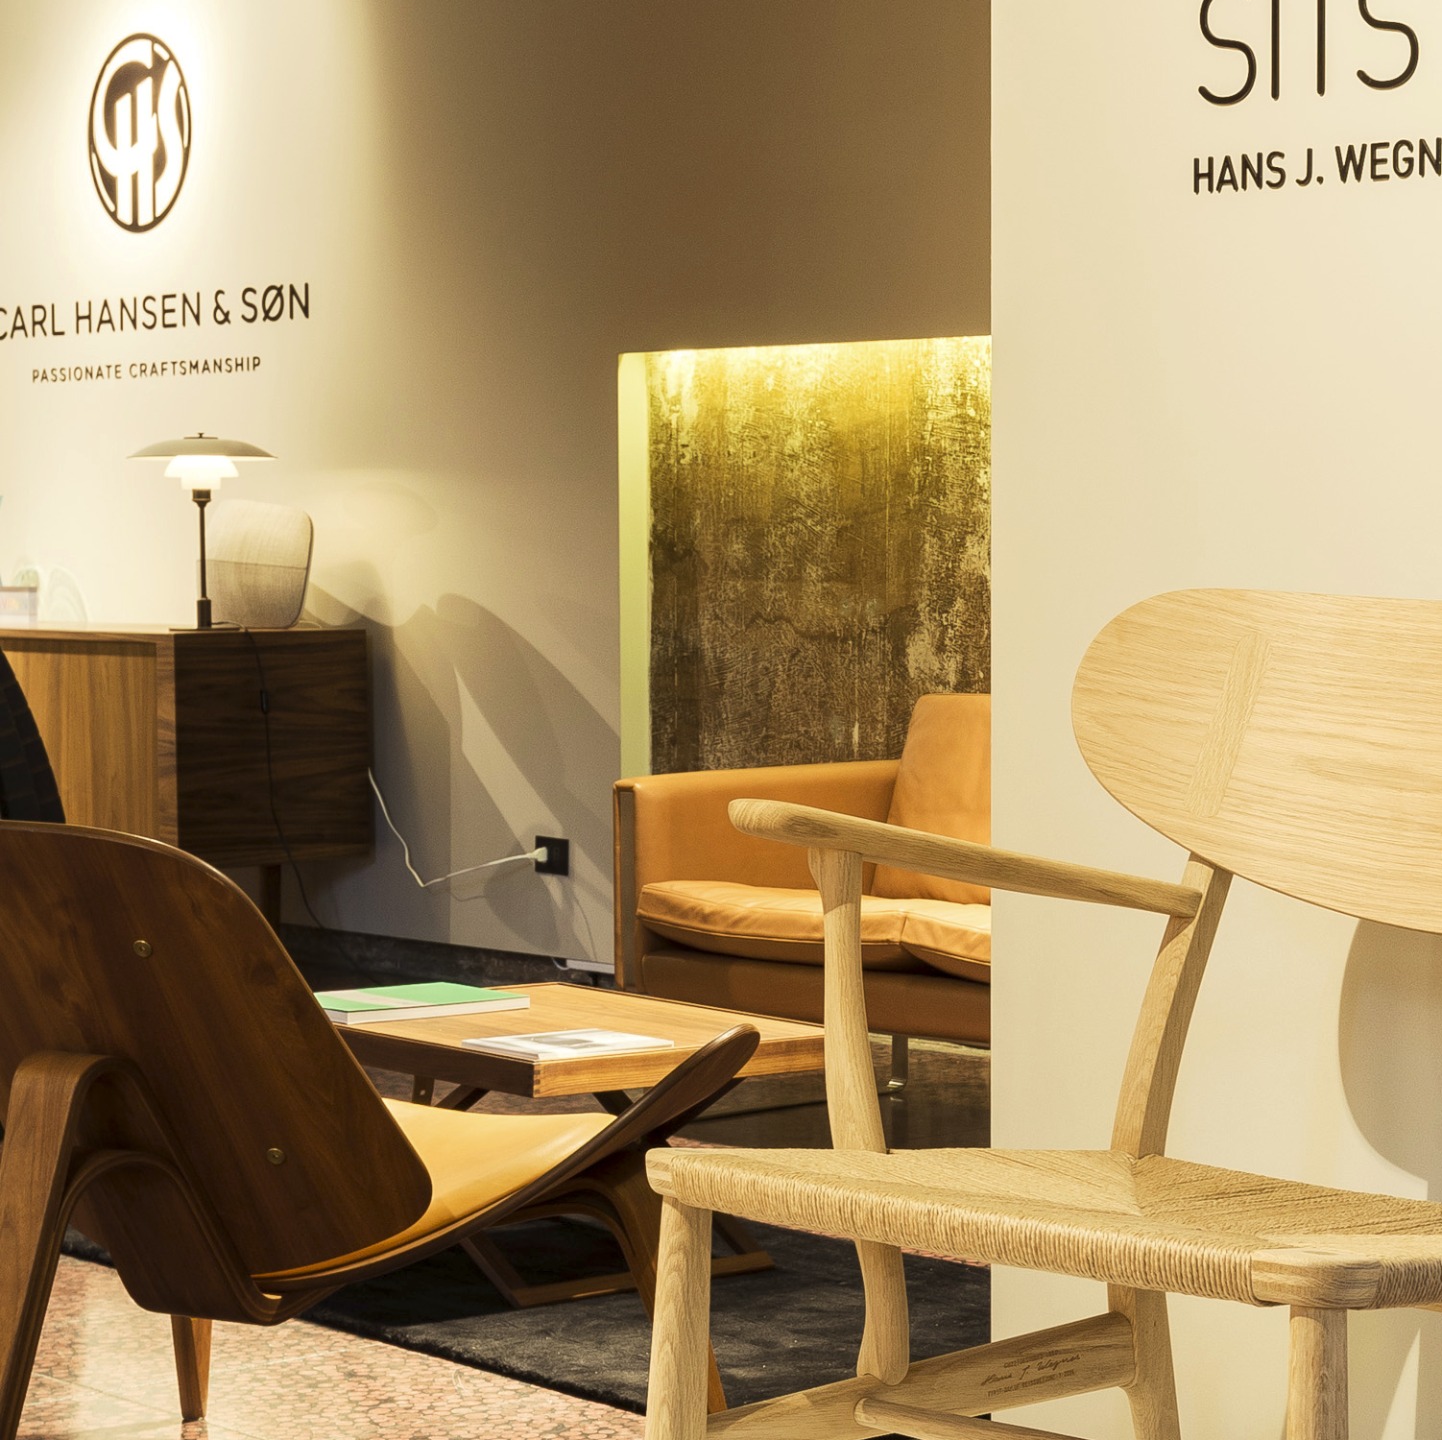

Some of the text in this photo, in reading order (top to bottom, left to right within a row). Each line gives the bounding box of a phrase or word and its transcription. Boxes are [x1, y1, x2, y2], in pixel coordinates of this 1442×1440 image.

[1193, 148, 1286, 195] HANS
[1295, 148, 1327, 187] J.
[75, 291, 201, 335] HANSEN
[213, 289, 231, 326] &
[241, 282, 310, 324] SØN
[32, 356, 262, 383] PASSIONATE CRAFTSMANSHIP
